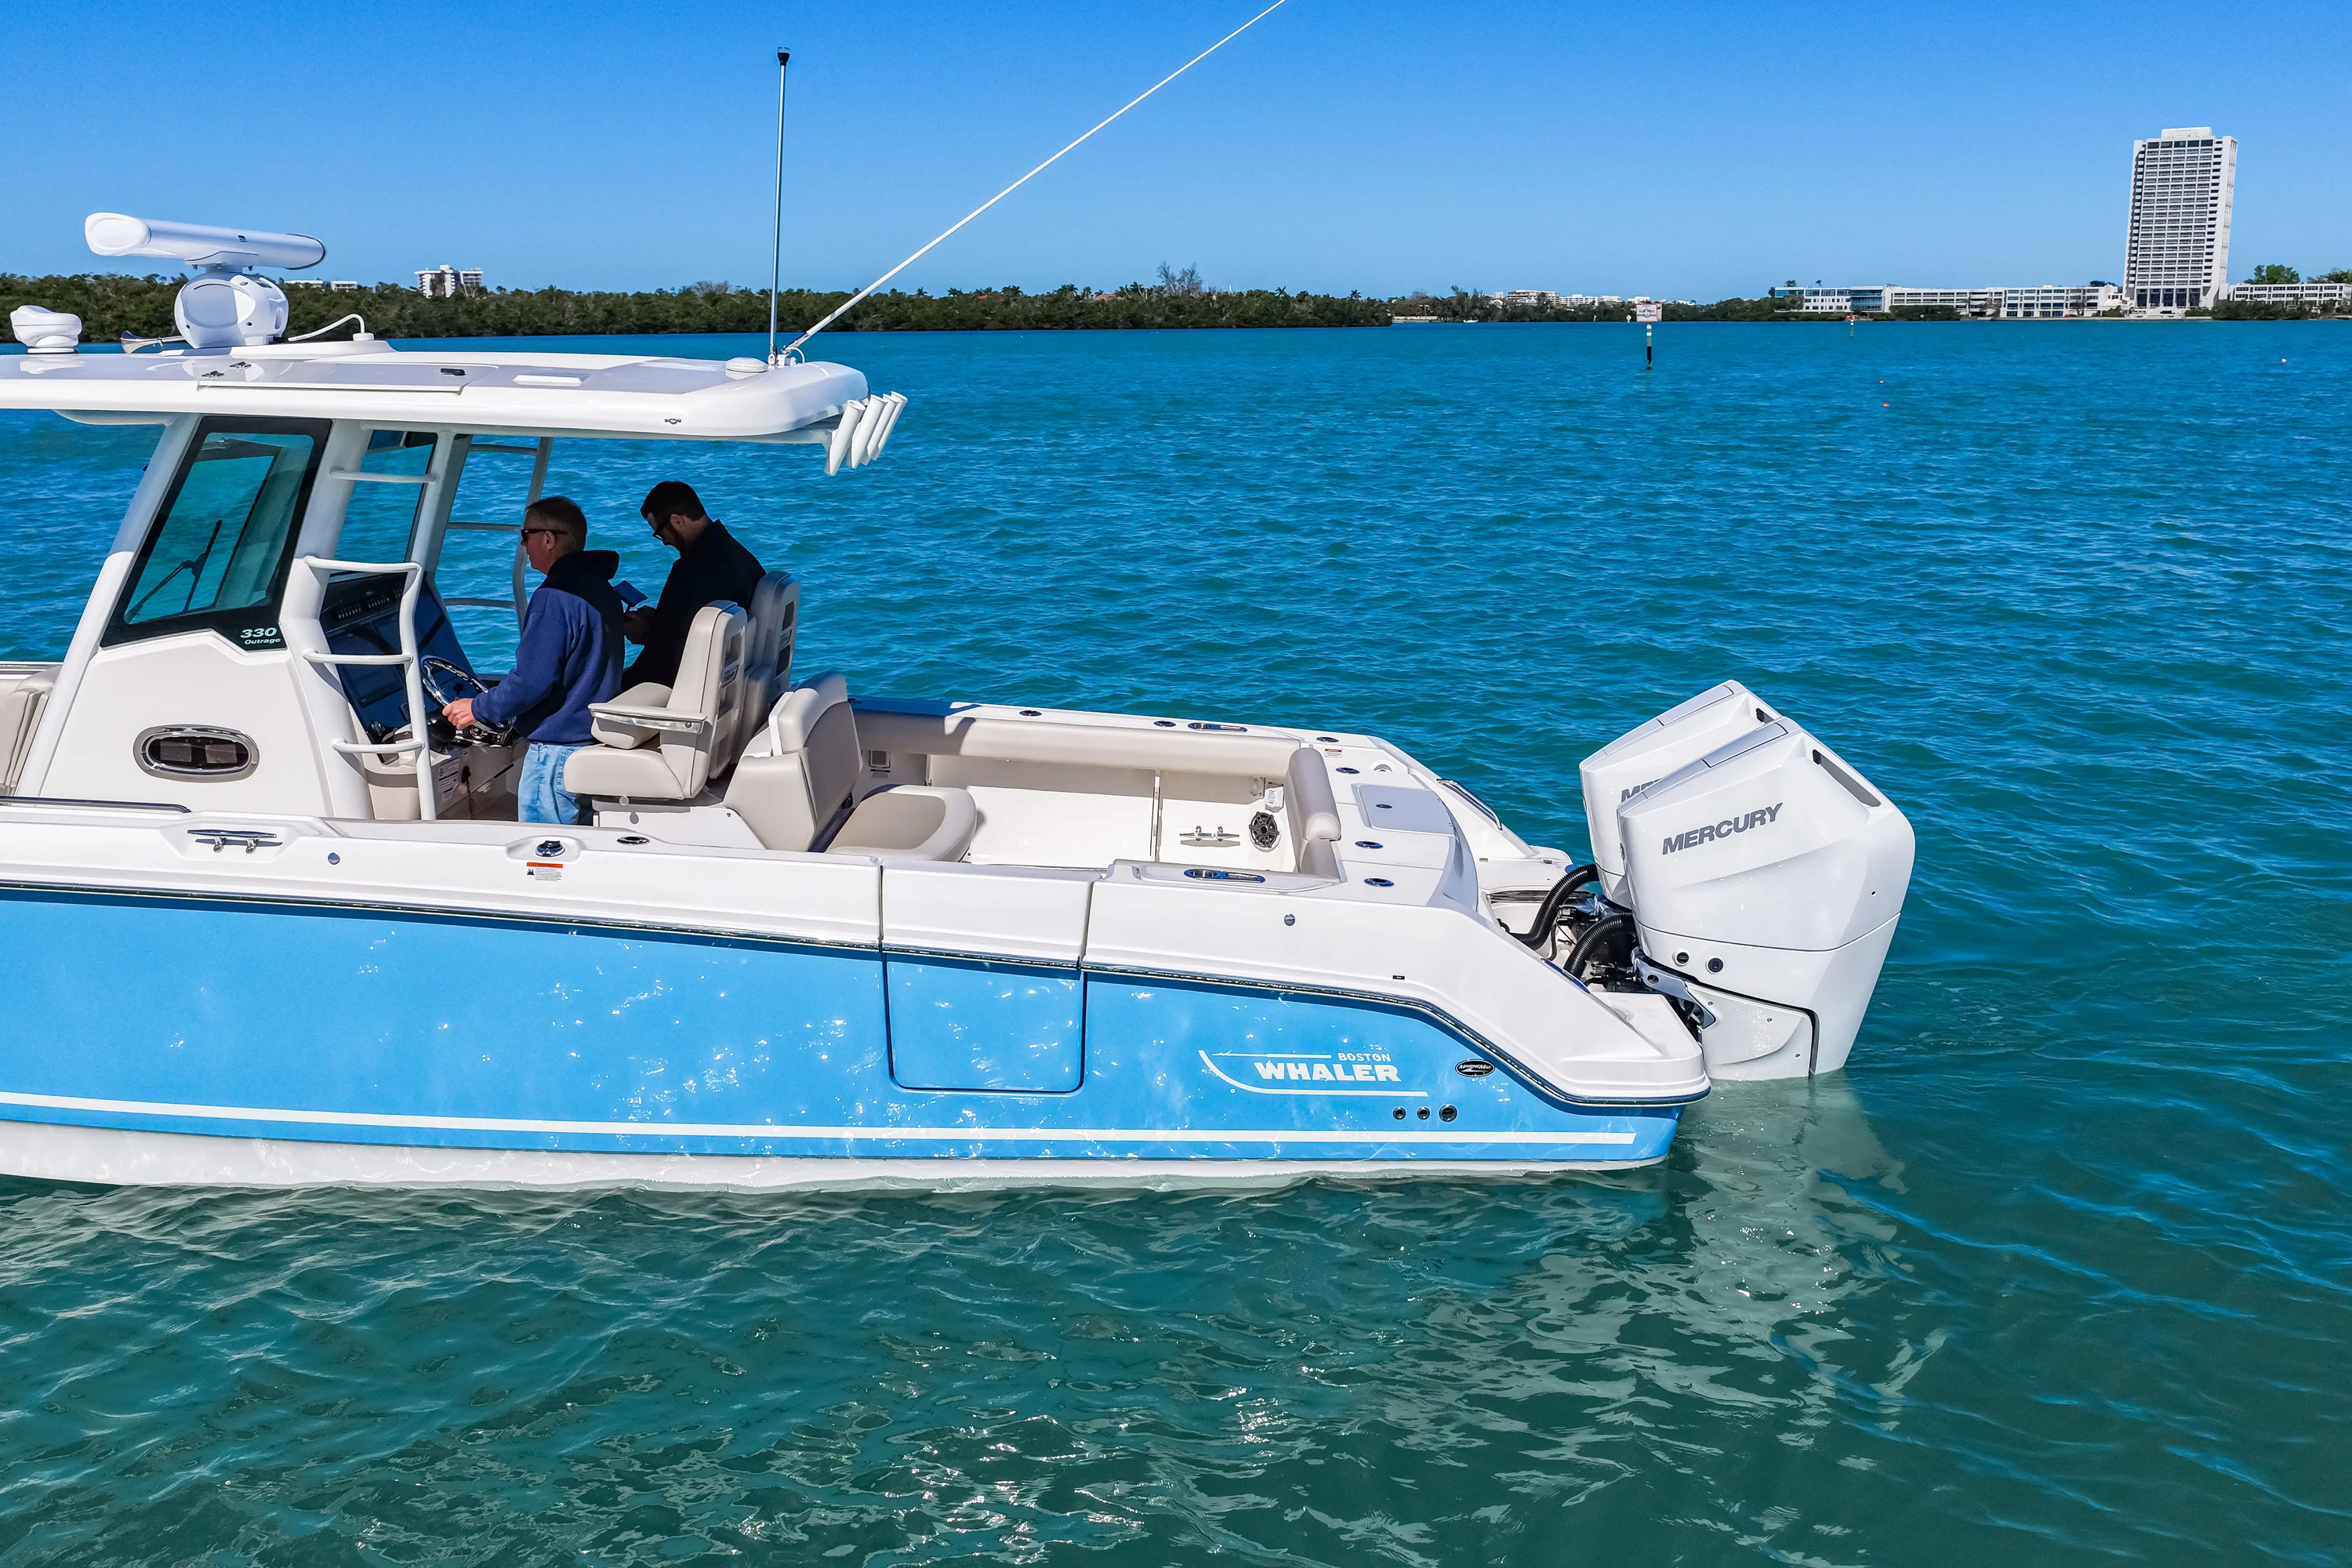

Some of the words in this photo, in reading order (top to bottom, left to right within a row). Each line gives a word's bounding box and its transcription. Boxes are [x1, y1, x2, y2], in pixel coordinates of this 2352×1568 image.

[240, 627, 278, 639] 330
[1662, 802, 1784, 855] MERCURY
[1338, 1052, 1392, 1062] BOSTON
[1254, 1062, 1402, 1082] WHALER
